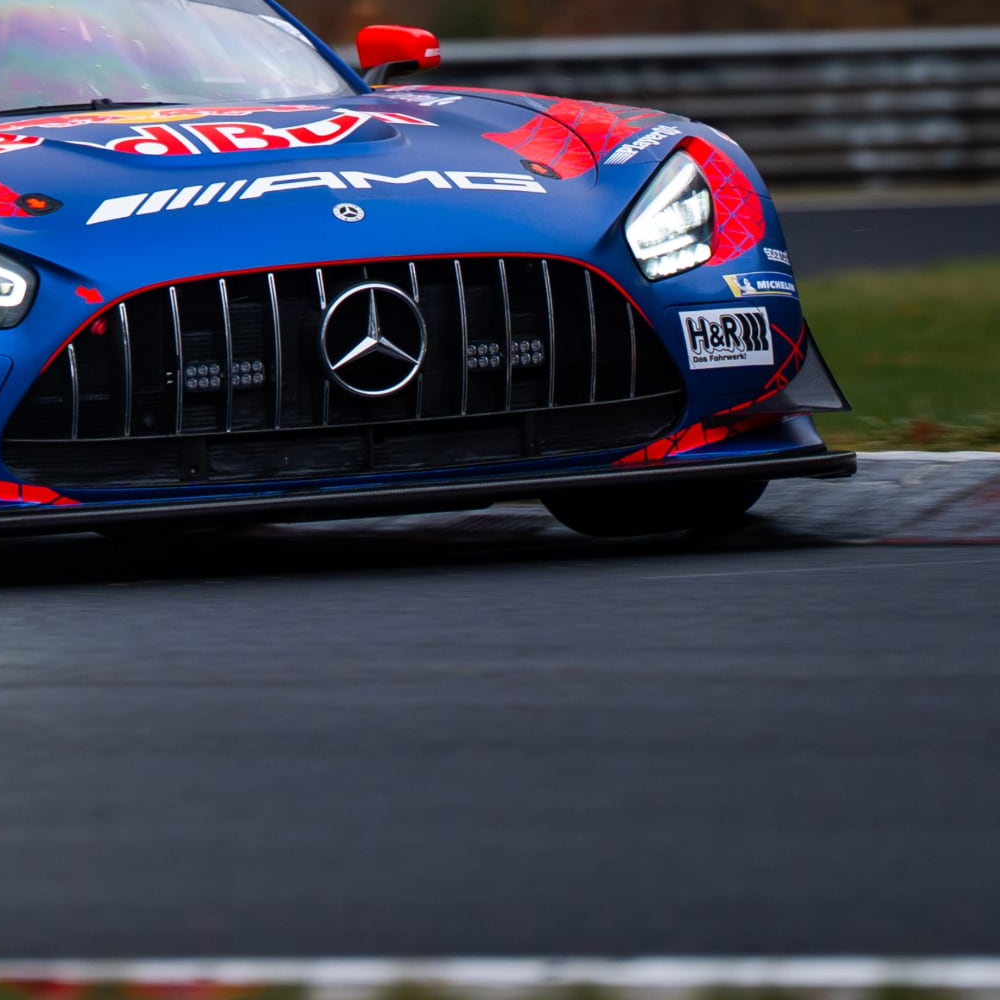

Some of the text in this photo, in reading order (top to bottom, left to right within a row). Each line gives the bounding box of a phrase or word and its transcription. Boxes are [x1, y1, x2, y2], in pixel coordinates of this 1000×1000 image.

[239, 171, 548, 200] AMG
[686, 314, 742, 354] H&R
[693, 355, 708, 363] Das
